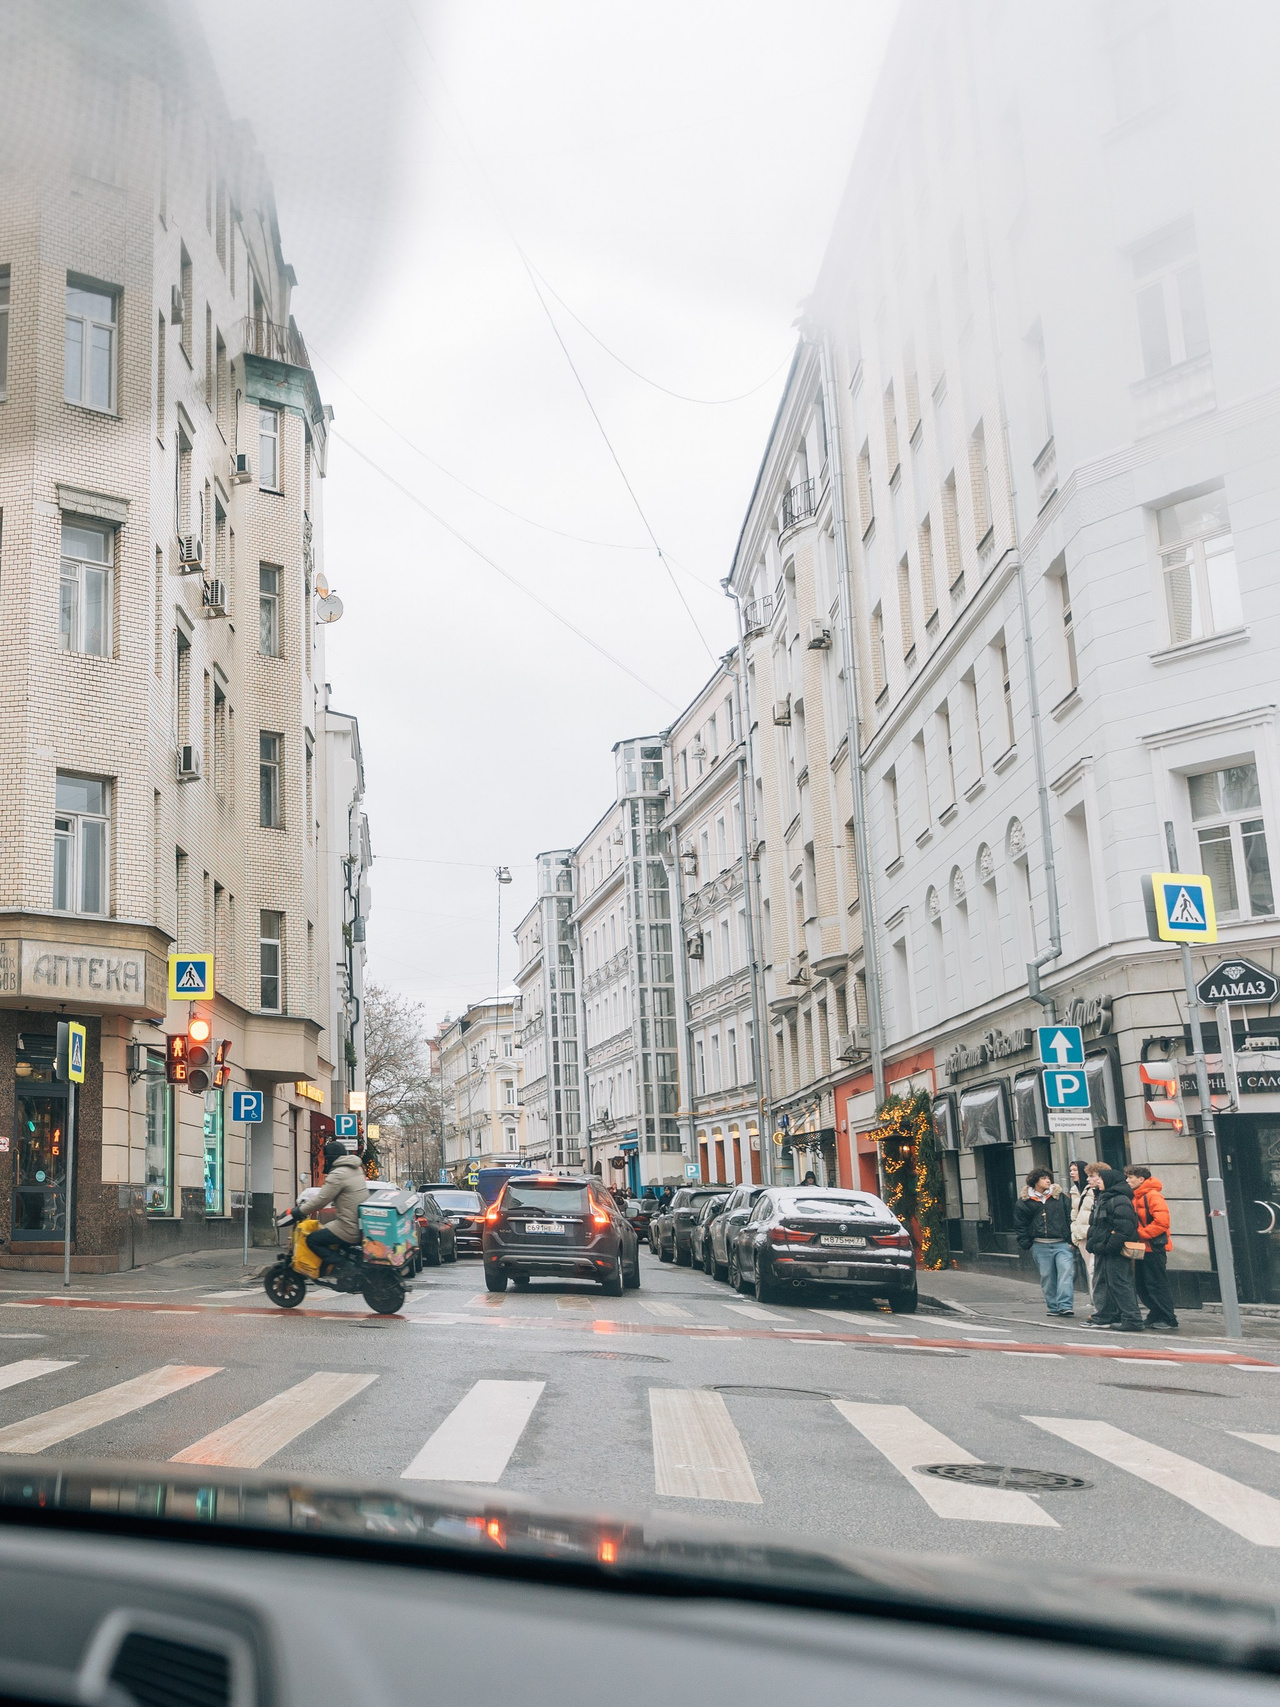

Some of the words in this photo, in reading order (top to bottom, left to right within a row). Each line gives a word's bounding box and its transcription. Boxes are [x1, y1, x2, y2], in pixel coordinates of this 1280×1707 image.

[33, 953, 140, 993] АПТЕКА
[1208, 981, 1267, 998] АЛМАЗ
[1055, 1074, 1080, 1104] P
[240, 1094, 257, 1118] P
[341, 1116, 354, 1134] P
[687, 1165, 696, 1176] P
